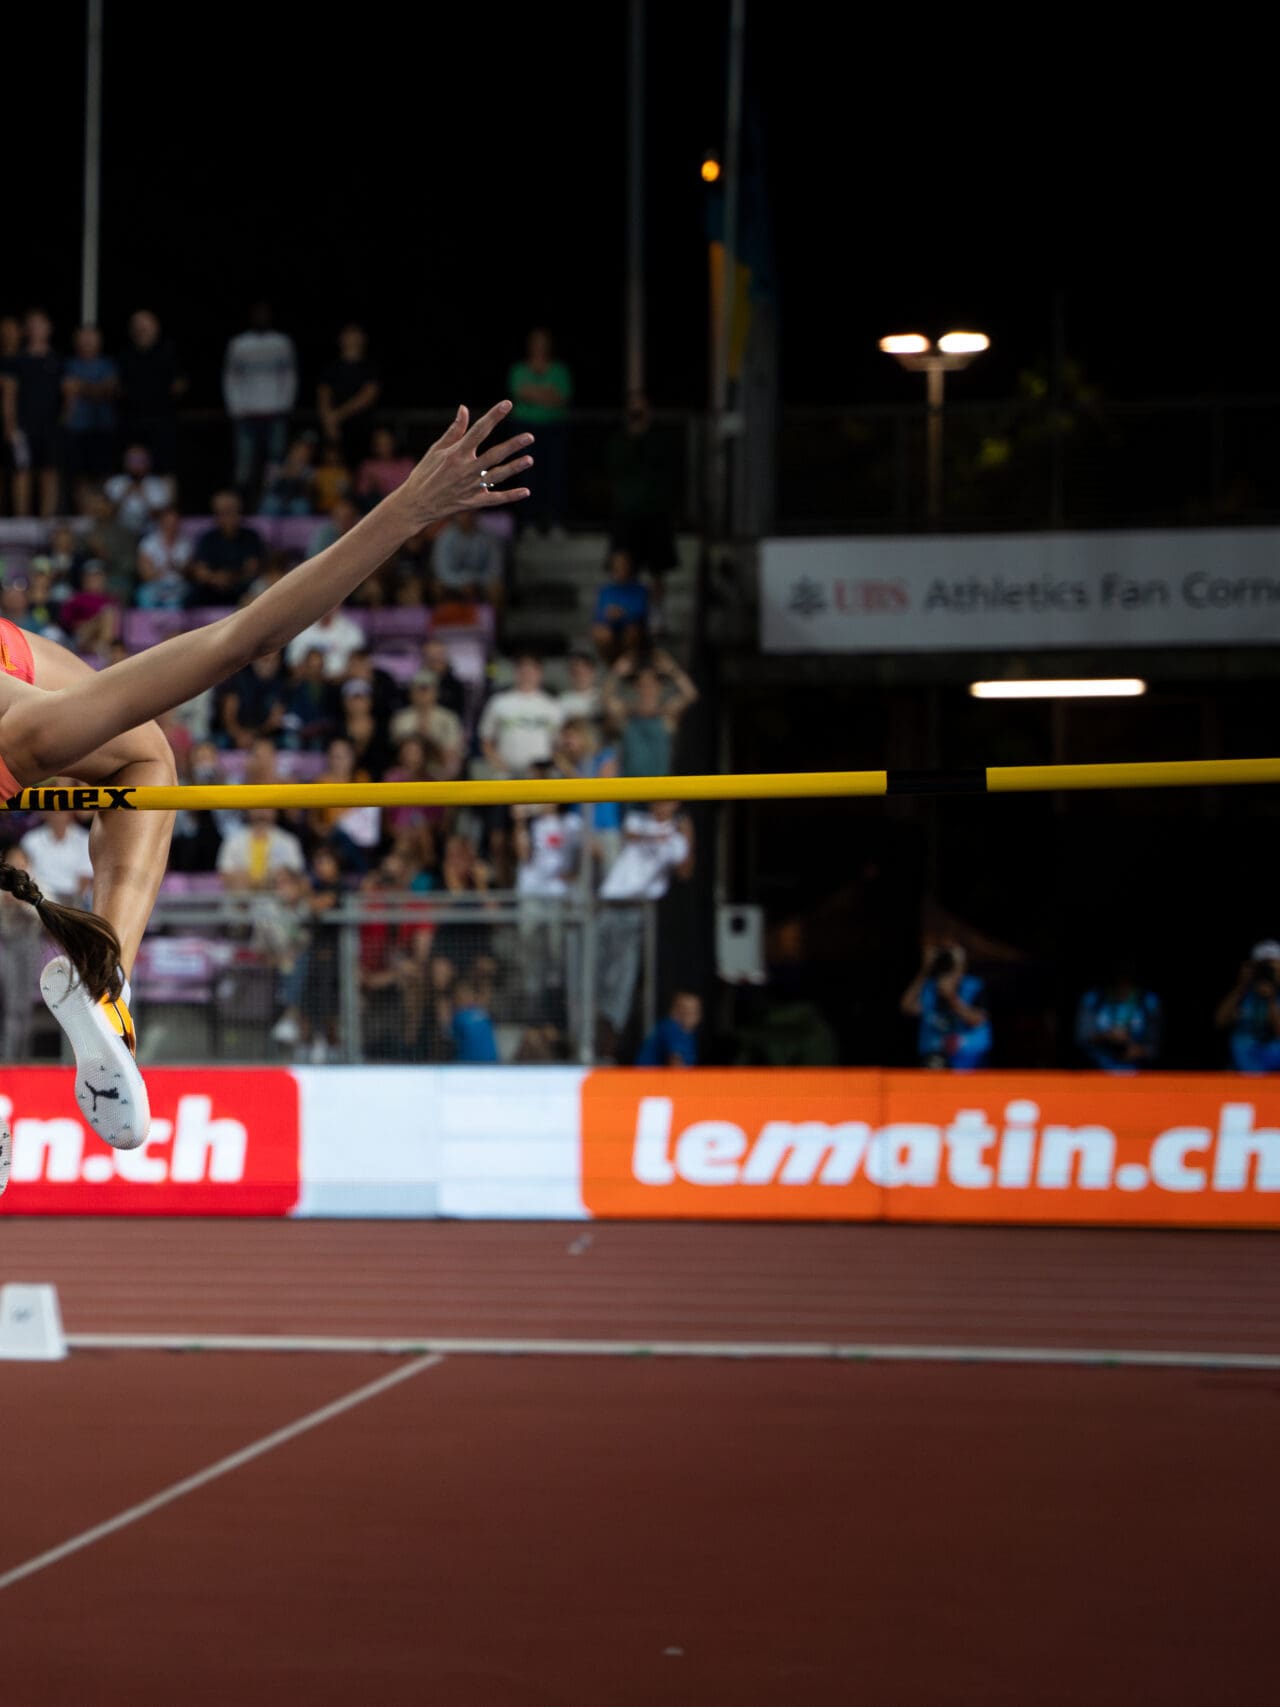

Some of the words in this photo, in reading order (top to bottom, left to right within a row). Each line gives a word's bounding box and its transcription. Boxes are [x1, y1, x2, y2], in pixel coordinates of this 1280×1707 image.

[923, 572, 1090, 615] Athletics
[1100, 570, 1171, 611] Fan
[1180, 569, 1280, 609] Corn
[632, 1097, 1280, 1191] lematin.ch
